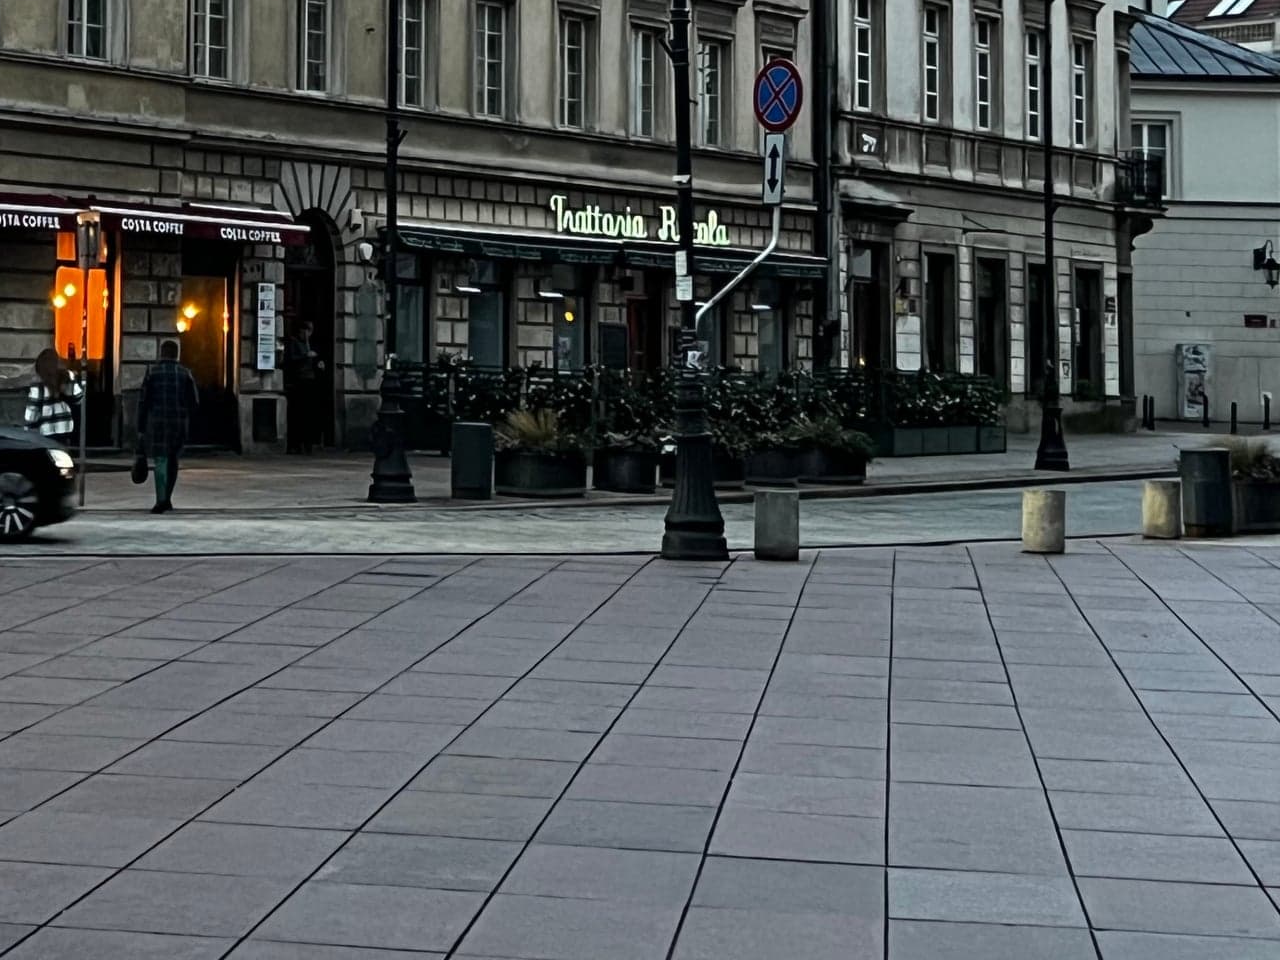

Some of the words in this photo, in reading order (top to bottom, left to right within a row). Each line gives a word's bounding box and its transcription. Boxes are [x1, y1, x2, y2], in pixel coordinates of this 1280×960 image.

[22, 214, 61, 230] COFFEE
[121, 217, 152, 232] COSTA
[550, 194, 648, 238] Trattoria
[658, 205, 731, 246] Rola
